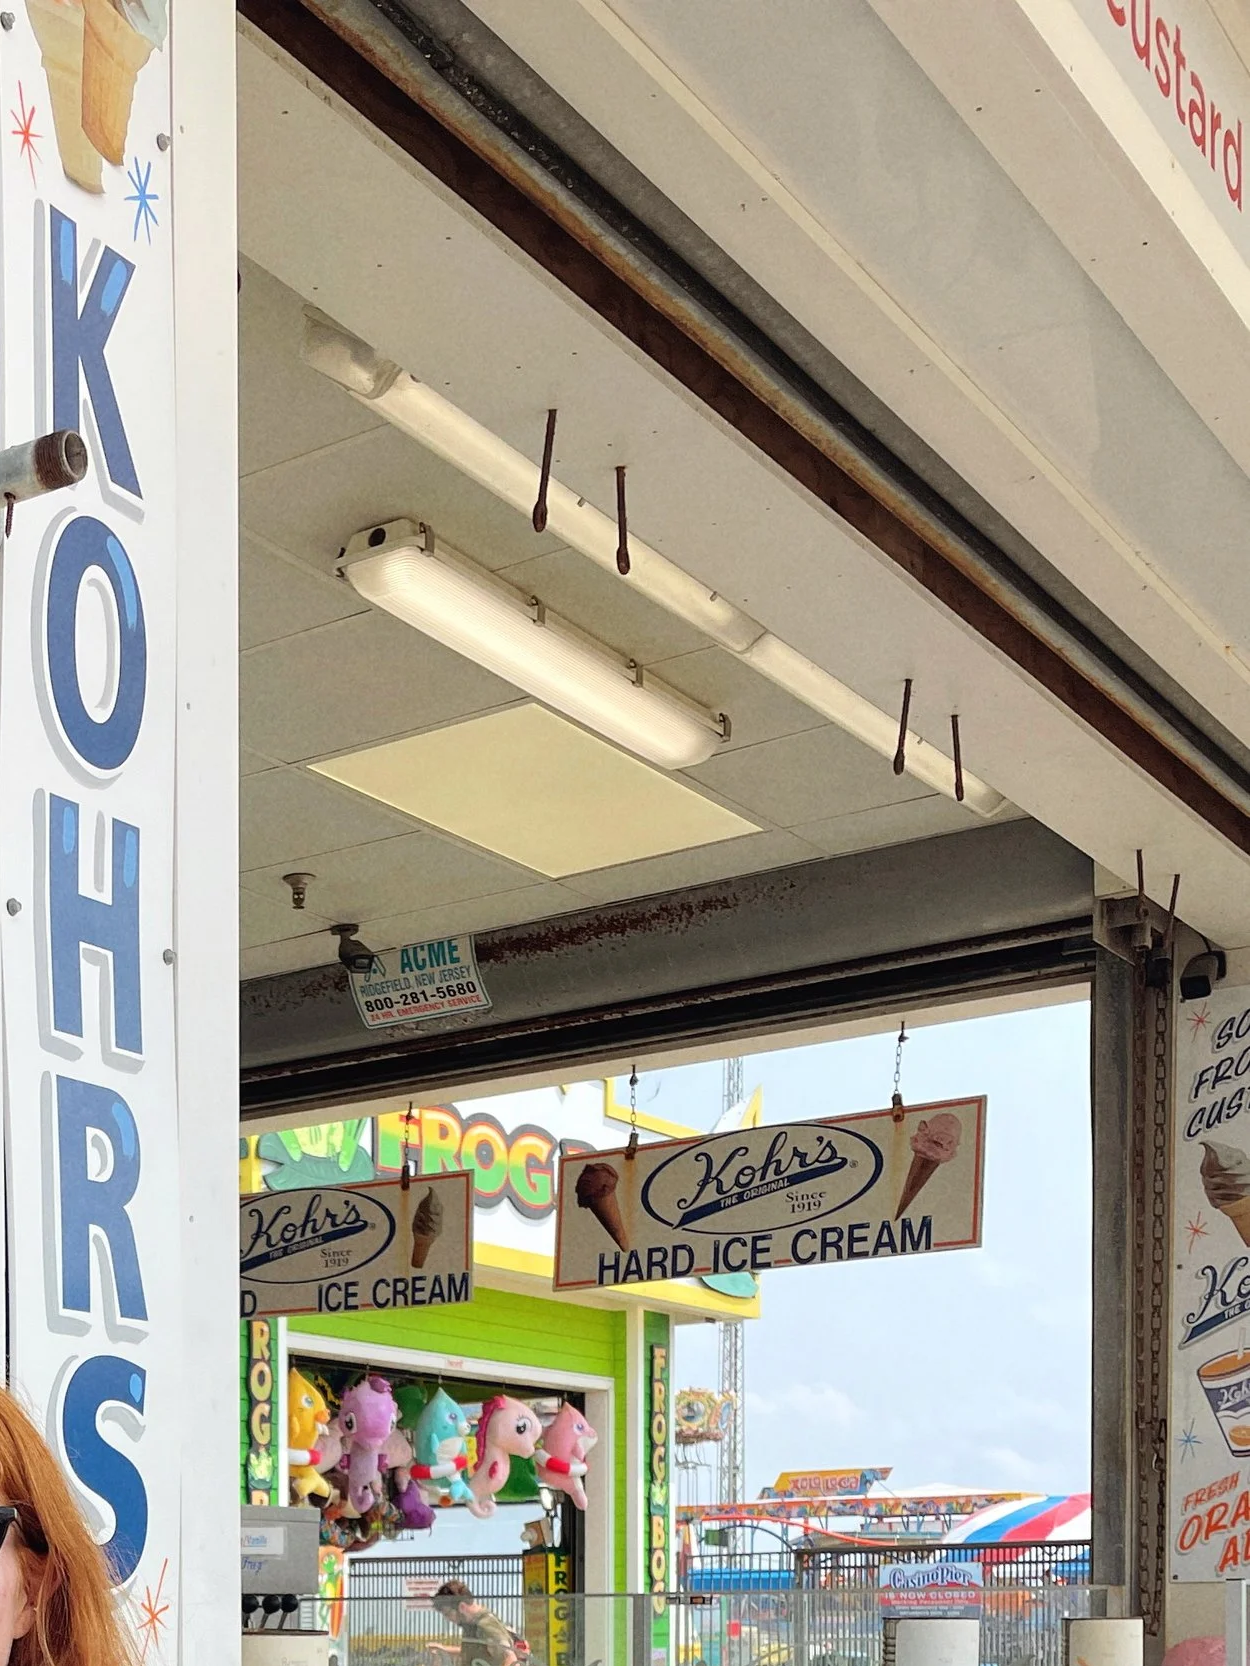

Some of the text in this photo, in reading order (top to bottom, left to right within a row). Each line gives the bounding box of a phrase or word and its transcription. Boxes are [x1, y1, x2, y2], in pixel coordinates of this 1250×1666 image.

[46, 203, 149, 1586] KOHRS
[400, 938, 461, 975] ACME
[414, 972, 436, 988] NEW
[439, 965, 472, 984] JERSEY
[364, 980, 477, 1013] 800-281-5680
[397, 1001, 446, 1017] EMERGENCY
[448, 994, 483, 1008] SERVICE
[1186, 1086, 1250, 1138] CUS
[375, 1104, 554, 1211] FROG
[677, 1130, 848, 1210] Kohr's
[719, 1177, 791, 1209] THE ORIGINAL
[785, 1190, 827, 1204] Since
[789, 1199, 822, 1214] 1919
[240, 1193, 369, 1260] Kohr's
[323, 1258, 350, 1268] 1919
[598, 1215, 933, 1286] HARD ICE CREAM
[317, 1271, 470, 1313] ICE CREAM
[652, 1346, 667, 1484] FROG
[1182, 1470, 1242, 1513] FRESH
[890, 1564, 973, 1590] Casino Pier
[900, 1591, 927, 1600] NOW
[930, 1590, 976, 1600] CLOSED
